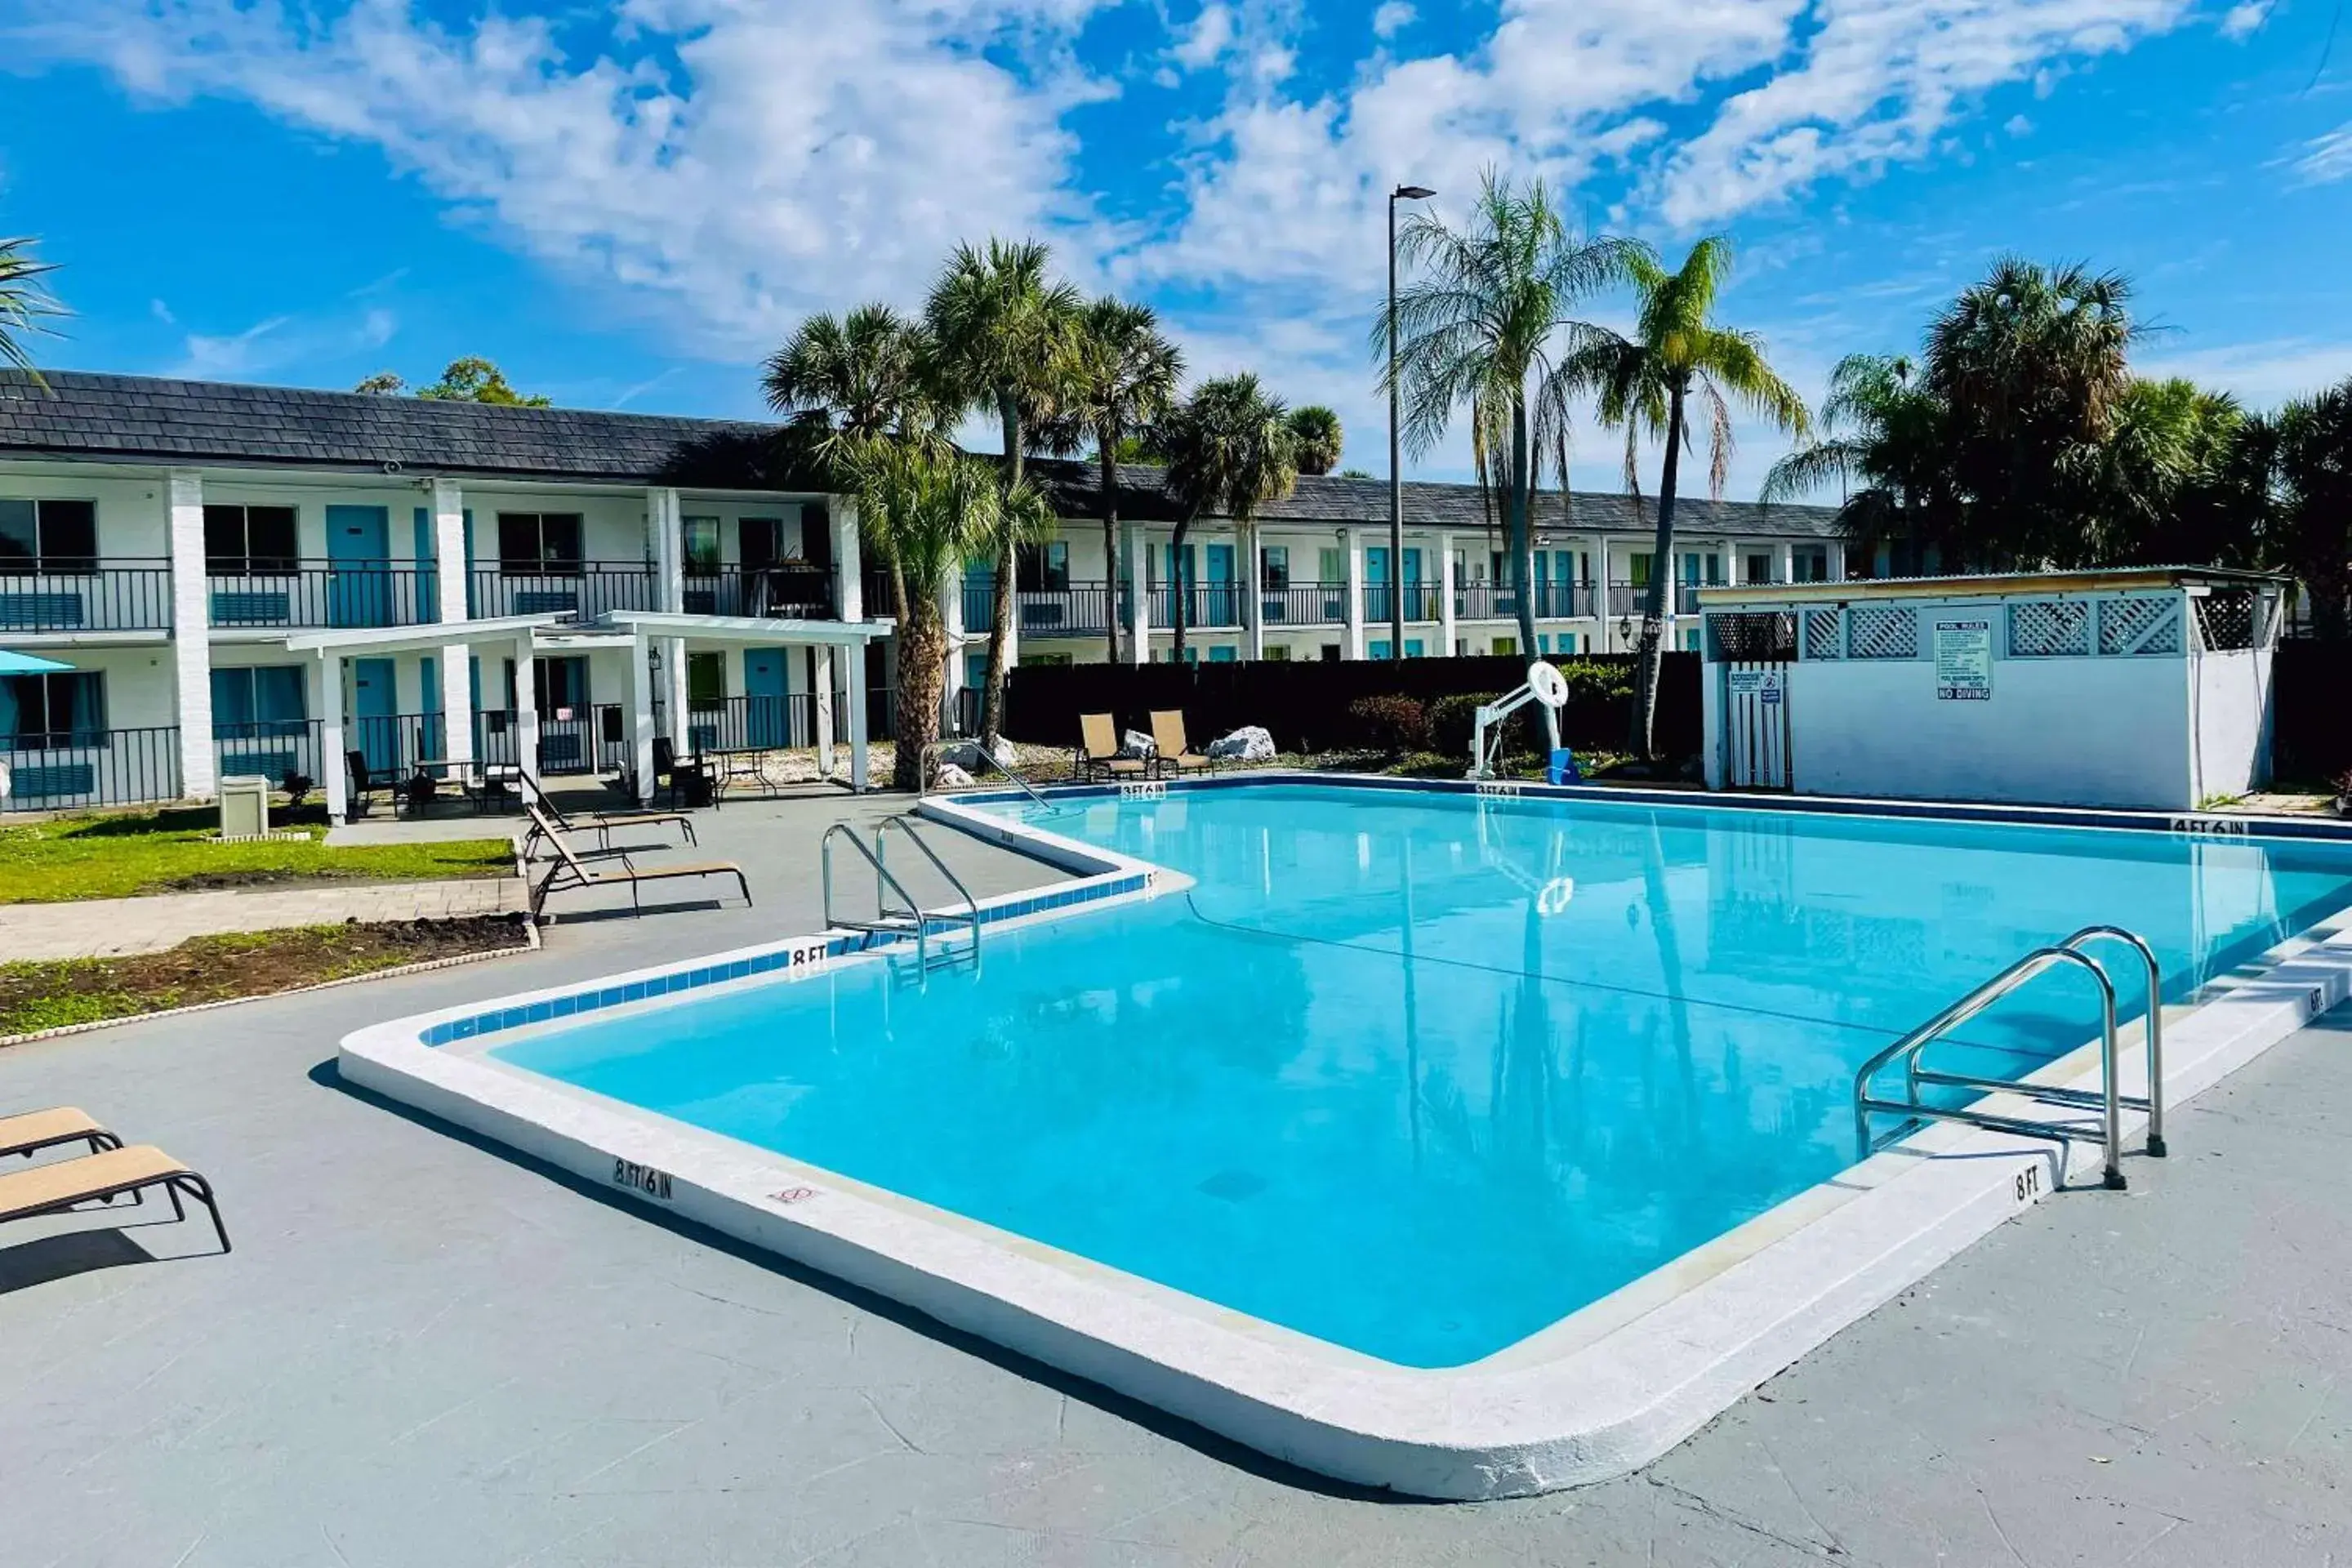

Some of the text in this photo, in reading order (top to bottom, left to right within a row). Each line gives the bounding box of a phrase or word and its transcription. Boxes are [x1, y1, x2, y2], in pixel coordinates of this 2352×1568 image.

[1939, 689, 1989, 699] NO DIVING
[1133, 785, 1143, 795] FT
[2174, 819, 2243, 835] 4 FT 6 IN
[808, 945, 825, 962] FT
[616, 1159, 671, 1200] 8 FT 6 IN
[2016, 1165, 2038, 1200] 8 FT
